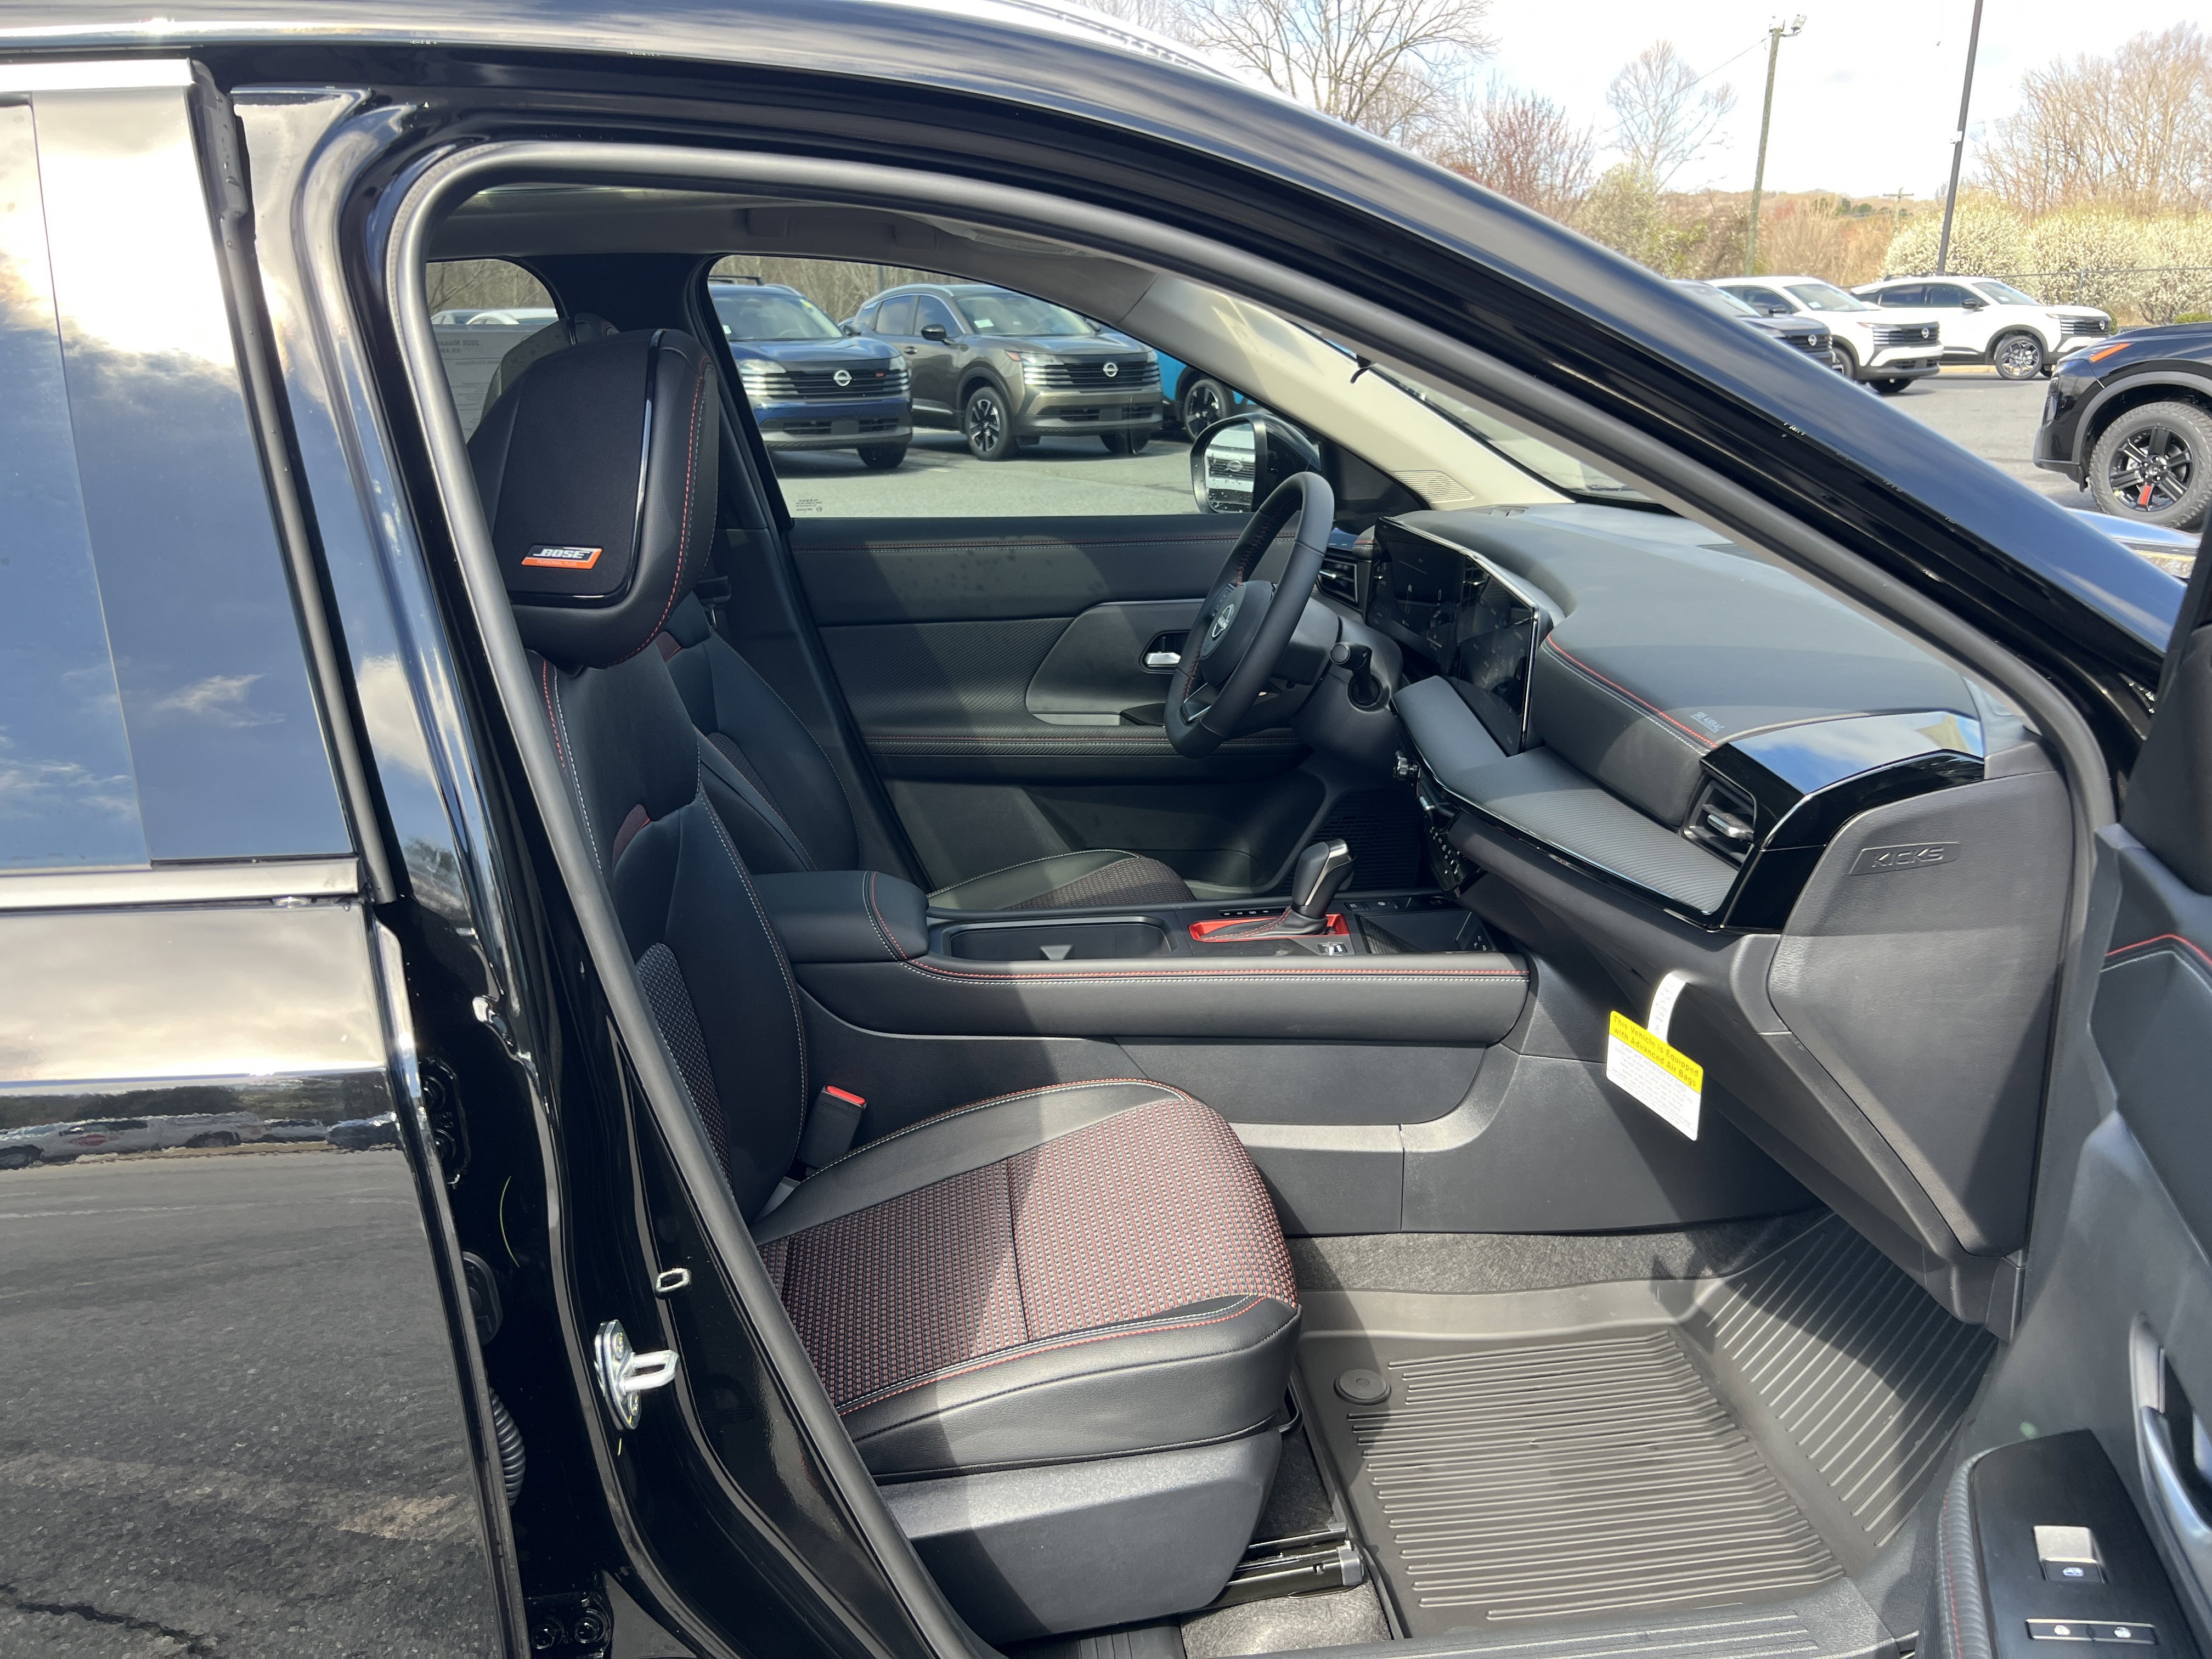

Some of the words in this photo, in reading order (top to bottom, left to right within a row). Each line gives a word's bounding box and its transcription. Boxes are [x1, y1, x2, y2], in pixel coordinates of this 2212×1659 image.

[533, 548, 590, 559] BOSE
[1871, 847, 1945, 868] KICKS
[1613, 1015, 1628, 1029] This
[1630, 1025, 1656, 1047] Vehicle
[1657, 1044, 1663, 1053] is
[1666, 1049, 1699, 1076] Equipped
[1613, 1027, 1628, 1041] with
[1630, 1037, 1664, 1065] Advanced
[1666, 1060, 1677, 1073] Air
[1679, 1069, 1696, 1087] Bags
